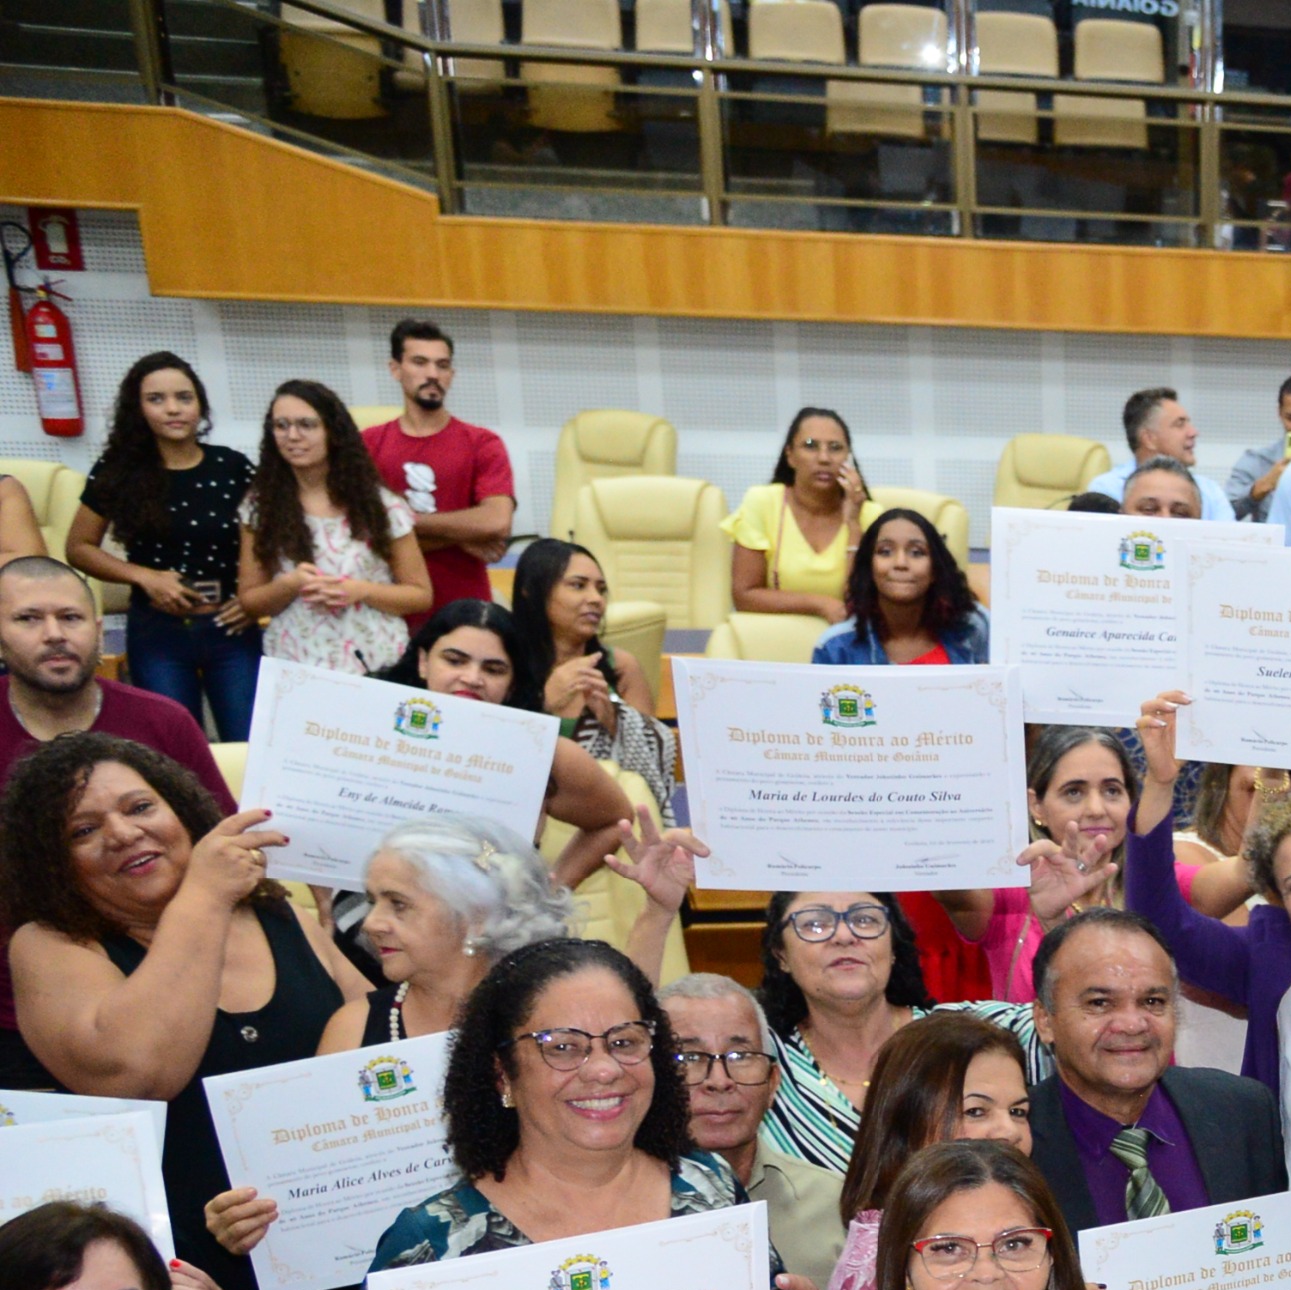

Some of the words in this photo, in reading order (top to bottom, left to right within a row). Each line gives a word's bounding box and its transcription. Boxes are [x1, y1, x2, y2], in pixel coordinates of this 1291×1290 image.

[1045, 626, 1096, 638] Genairce
[1101, 629, 1155, 642] Aparecida
[750, 789, 788, 800] Maria
[791, 790, 807, 801] de
[811, 791, 863, 802] Lourdes
[867, 791, 882, 802] do
[886, 791, 925, 802] Couto
[928, 790, 961, 801] Silva
[288, 1183, 327, 1198] Maria
[331, 1176, 363, 1190] Alice
[367, 1168, 401, 1182] Alves
[405, 1162, 419, 1173] de
[423, 1152, 451, 1169] Carv
